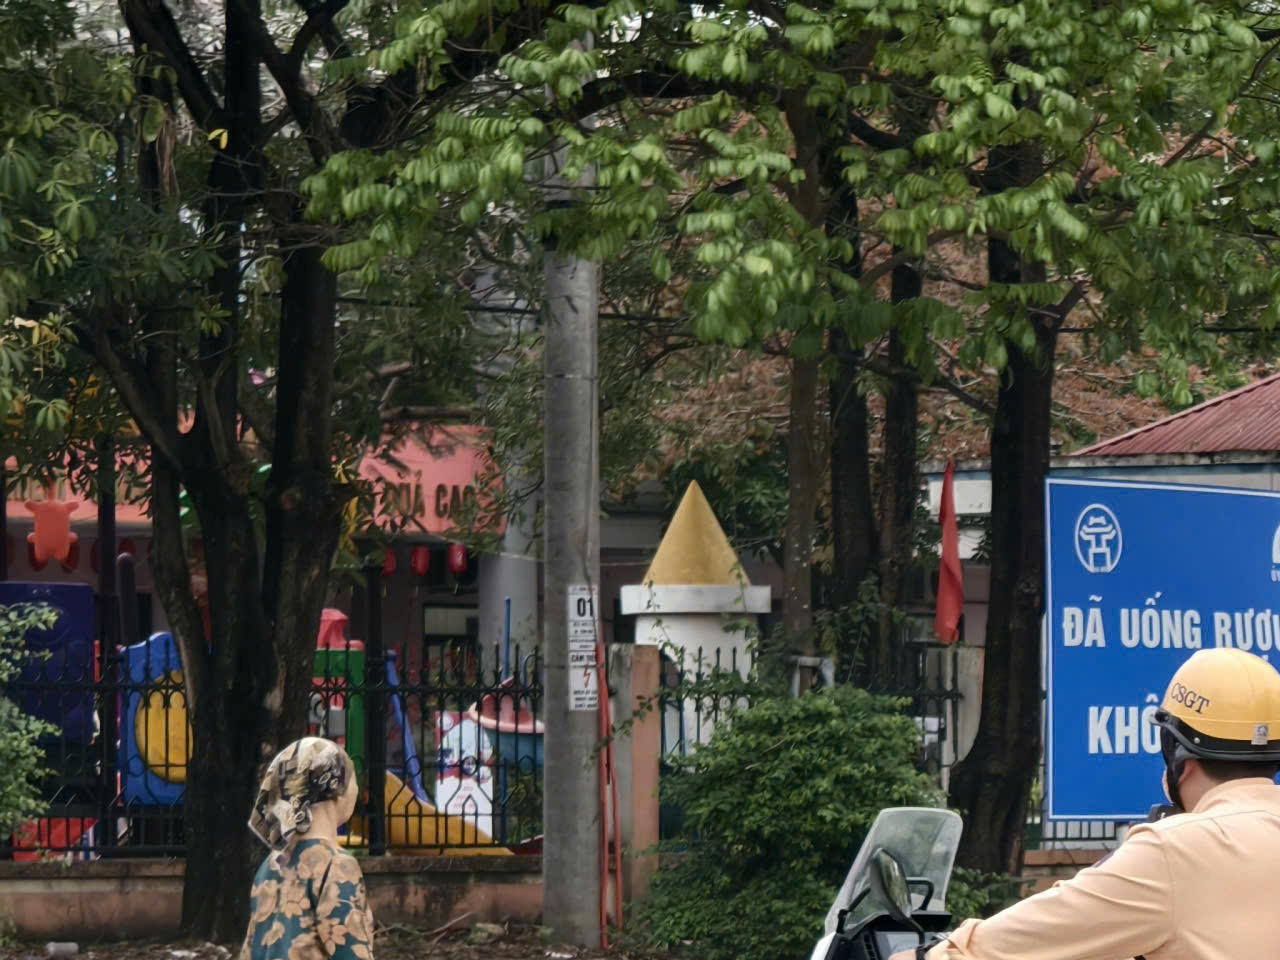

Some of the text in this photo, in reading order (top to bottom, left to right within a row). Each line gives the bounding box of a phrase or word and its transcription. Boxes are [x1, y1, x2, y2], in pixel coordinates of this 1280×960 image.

[577, 597, 594, 617] 01
[1062, 594, 1106, 648] ĐÃ
[1120, 591, 1201, 649] UỐNG
[1171, 682, 1210, 715] CSGT
[1088, 693, 1162, 755] KHÔ
